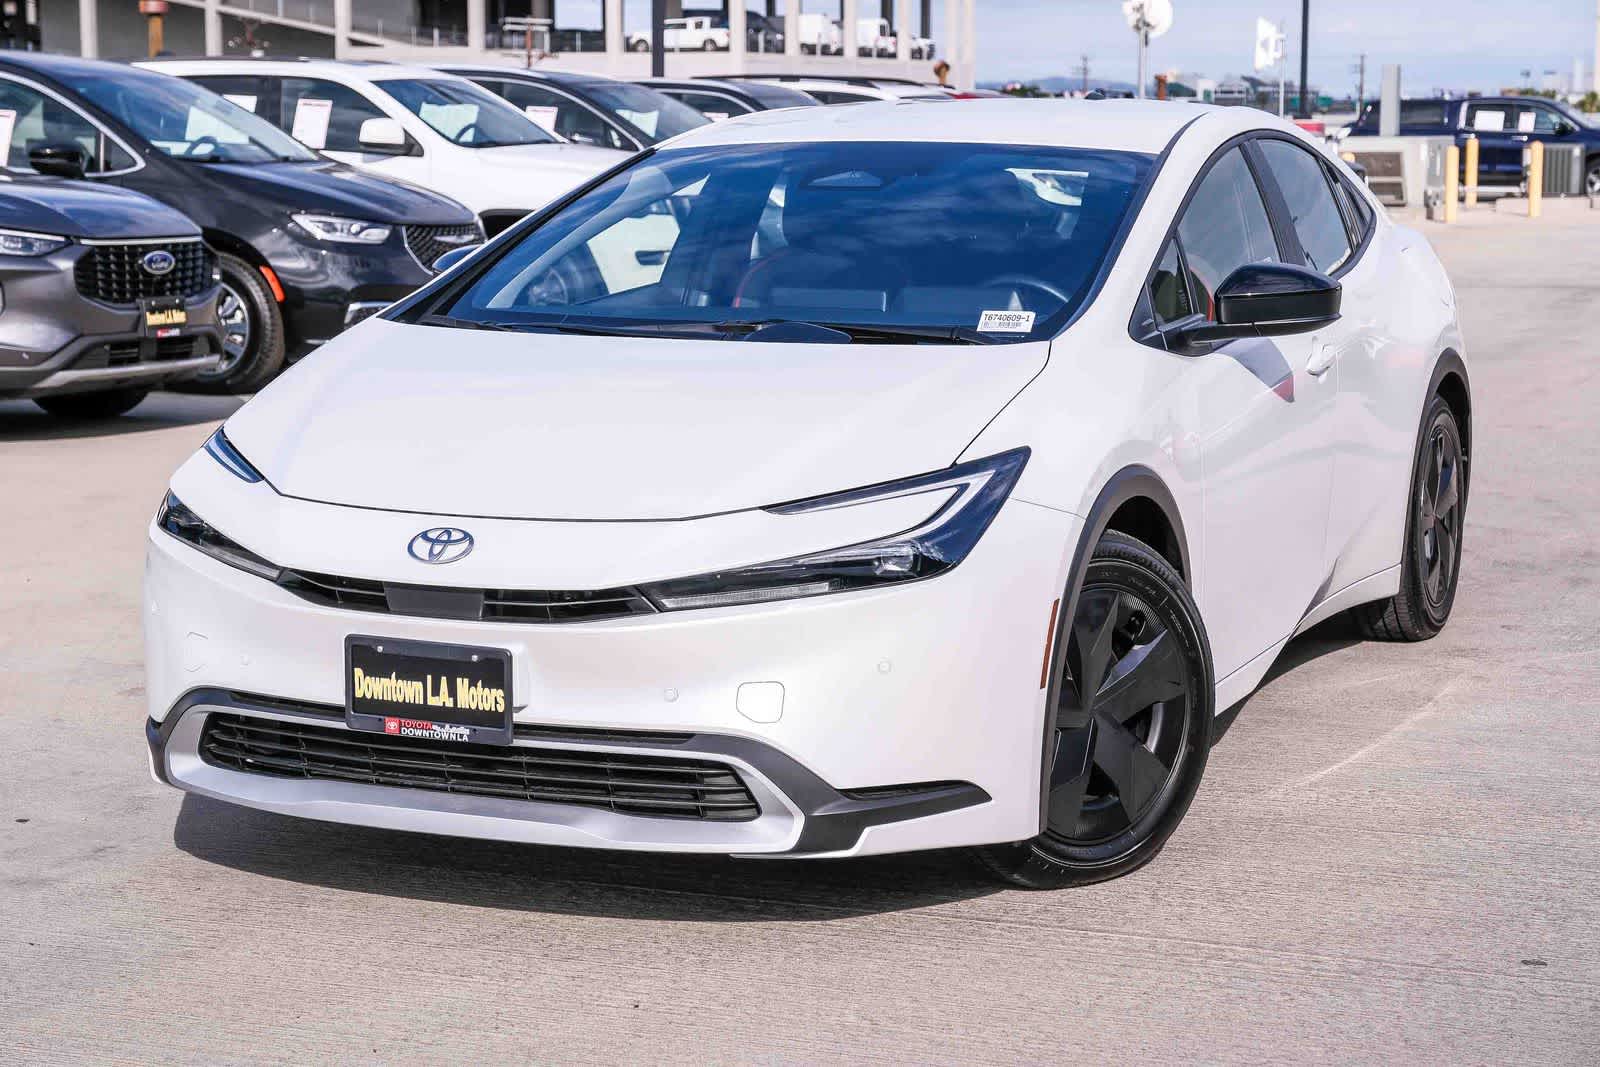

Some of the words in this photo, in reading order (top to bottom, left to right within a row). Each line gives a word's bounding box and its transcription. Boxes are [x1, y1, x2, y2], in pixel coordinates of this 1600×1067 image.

[354, 667, 424, 705] Downtown
[427, 675, 454, 708] L.A.
[457, 677, 505, 713] Motors
[400, 719, 433, 730] TOYOTA
